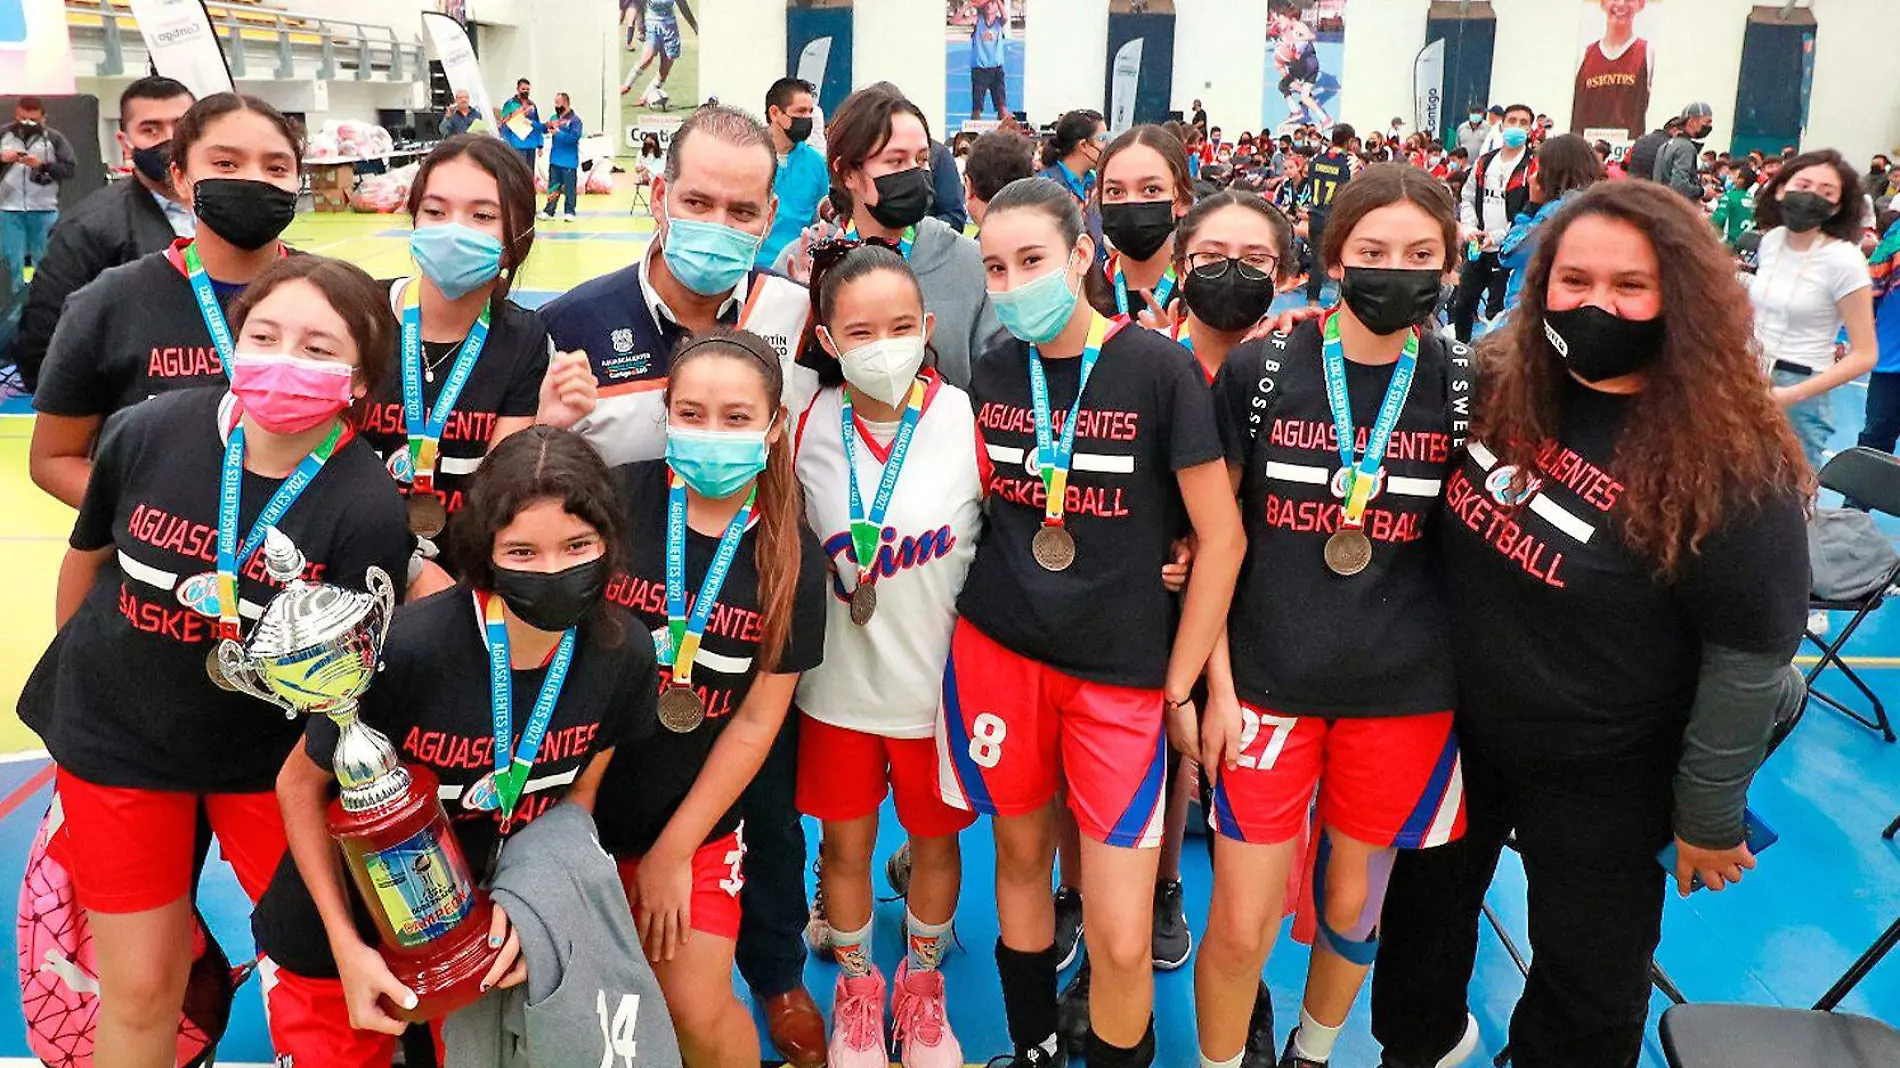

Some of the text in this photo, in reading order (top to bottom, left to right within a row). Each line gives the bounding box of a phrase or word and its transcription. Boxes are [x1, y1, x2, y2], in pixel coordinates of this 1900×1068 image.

[1313, 179, 1337, 206] 17
[148, 348, 222, 377] AGUAS
[404, 323, 420, 421] AGUASCALIENTES 2021
[433, 336, 482, 423] AGUASCALIENTES 2021
[1452, 342, 1469, 367] OF
[1330, 356, 1353, 451] AGUASCALIENTES 2021
[1369, 368, 1408, 460] AGUASCALIENTES 2021
[221, 442, 242, 555] AGUASCALIENTES 2021
[285, 470, 309, 495] 2021
[875, 422, 913, 510] AGUASCALIENTES 2021
[669, 502, 683, 601] AGUASCALIENTES 2021
[697, 522, 743, 619] AGUASCALIENTES 2021
[492, 642, 509, 754] AGUASCALIENTES 2021
[525, 635, 573, 745] AGUASCALIENTES 2021
[968, 712, 1008, 769] 8
[1237, 706, 1299, 770] 27
